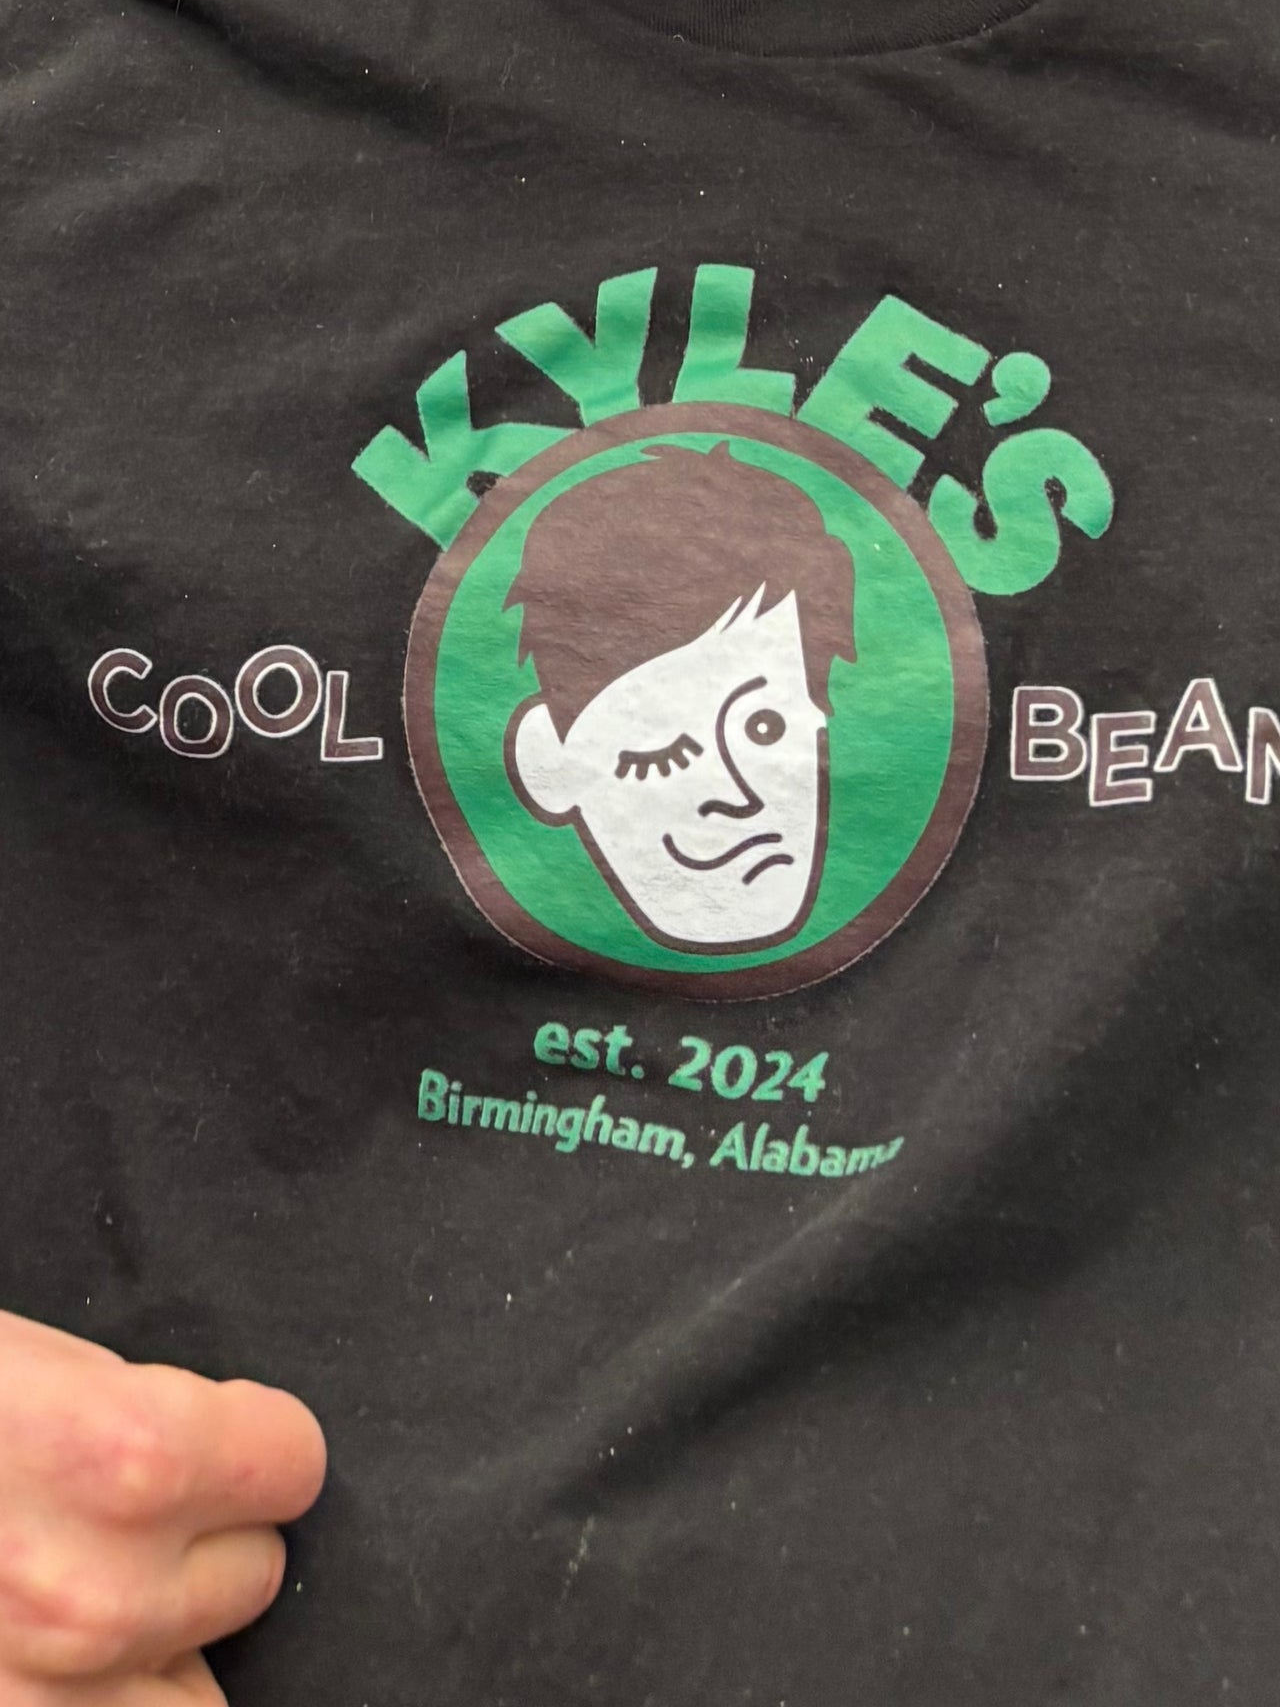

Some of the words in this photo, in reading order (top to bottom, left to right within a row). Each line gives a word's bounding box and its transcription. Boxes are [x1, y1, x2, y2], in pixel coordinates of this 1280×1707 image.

[351, 263, 1115, 597] KYLE'S
[87, 644, 383, 763] COOL
[533, 1021, 645, 1079] est.
[668, 1035, 830, 1103] 2024
[418, 1068, 696, 1169] Birmingham,
